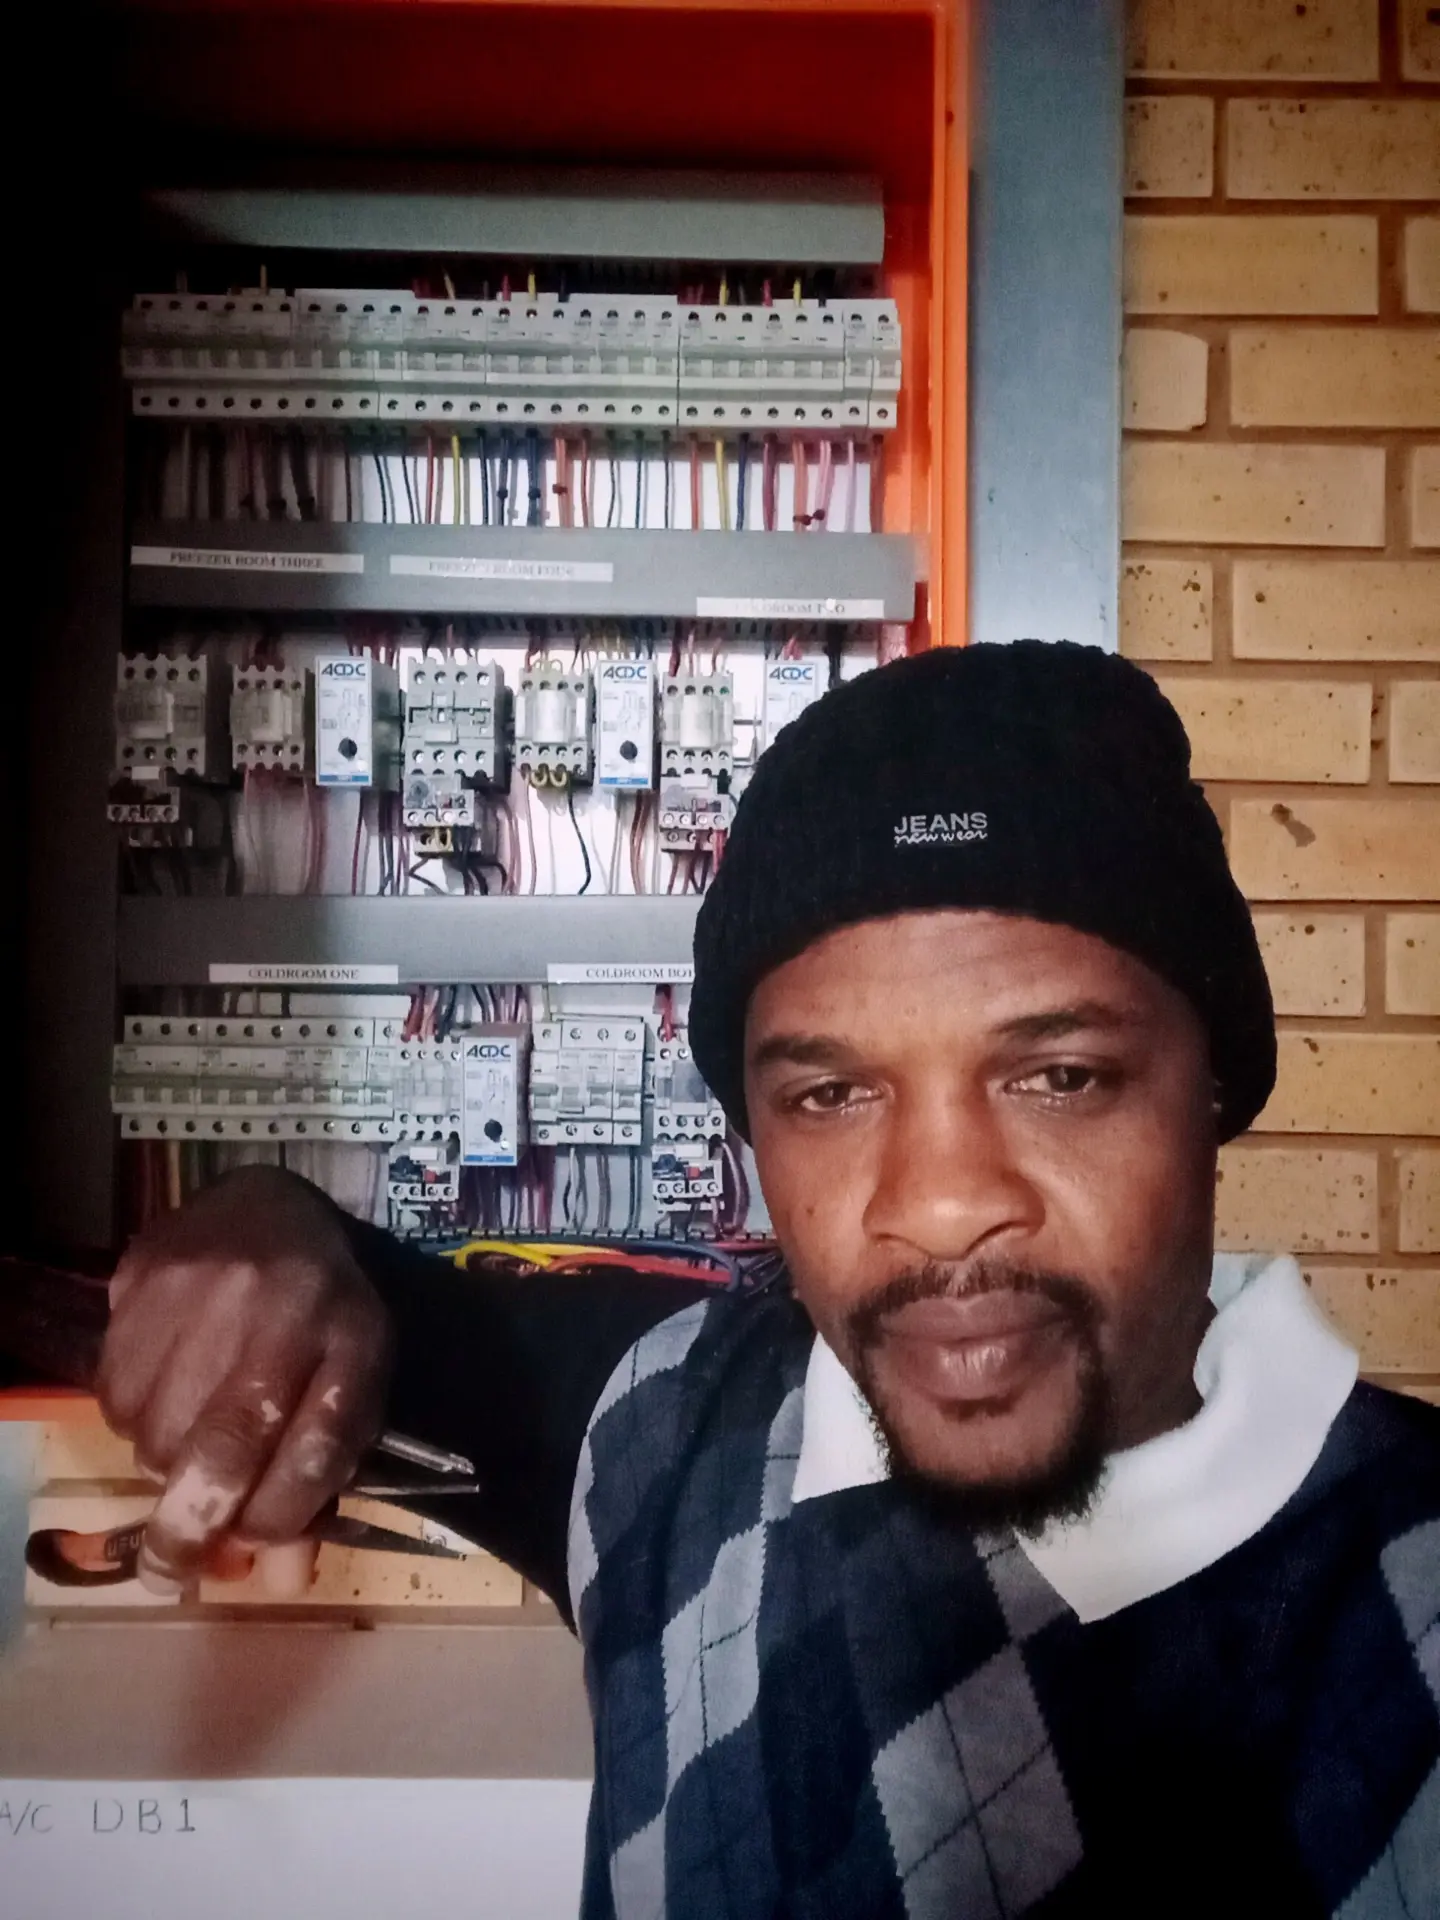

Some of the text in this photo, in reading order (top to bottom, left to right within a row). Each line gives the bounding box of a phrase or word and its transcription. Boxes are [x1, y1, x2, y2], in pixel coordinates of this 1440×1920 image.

[817, 603, 846, 615] TO
[893, 811, 988, 835] JEANS
[249, 968, 361, 980] COLDROOM ONE
[586, 967, 664, 979] COLDROOM
[466, 1044, 512, 1059] ACDC
